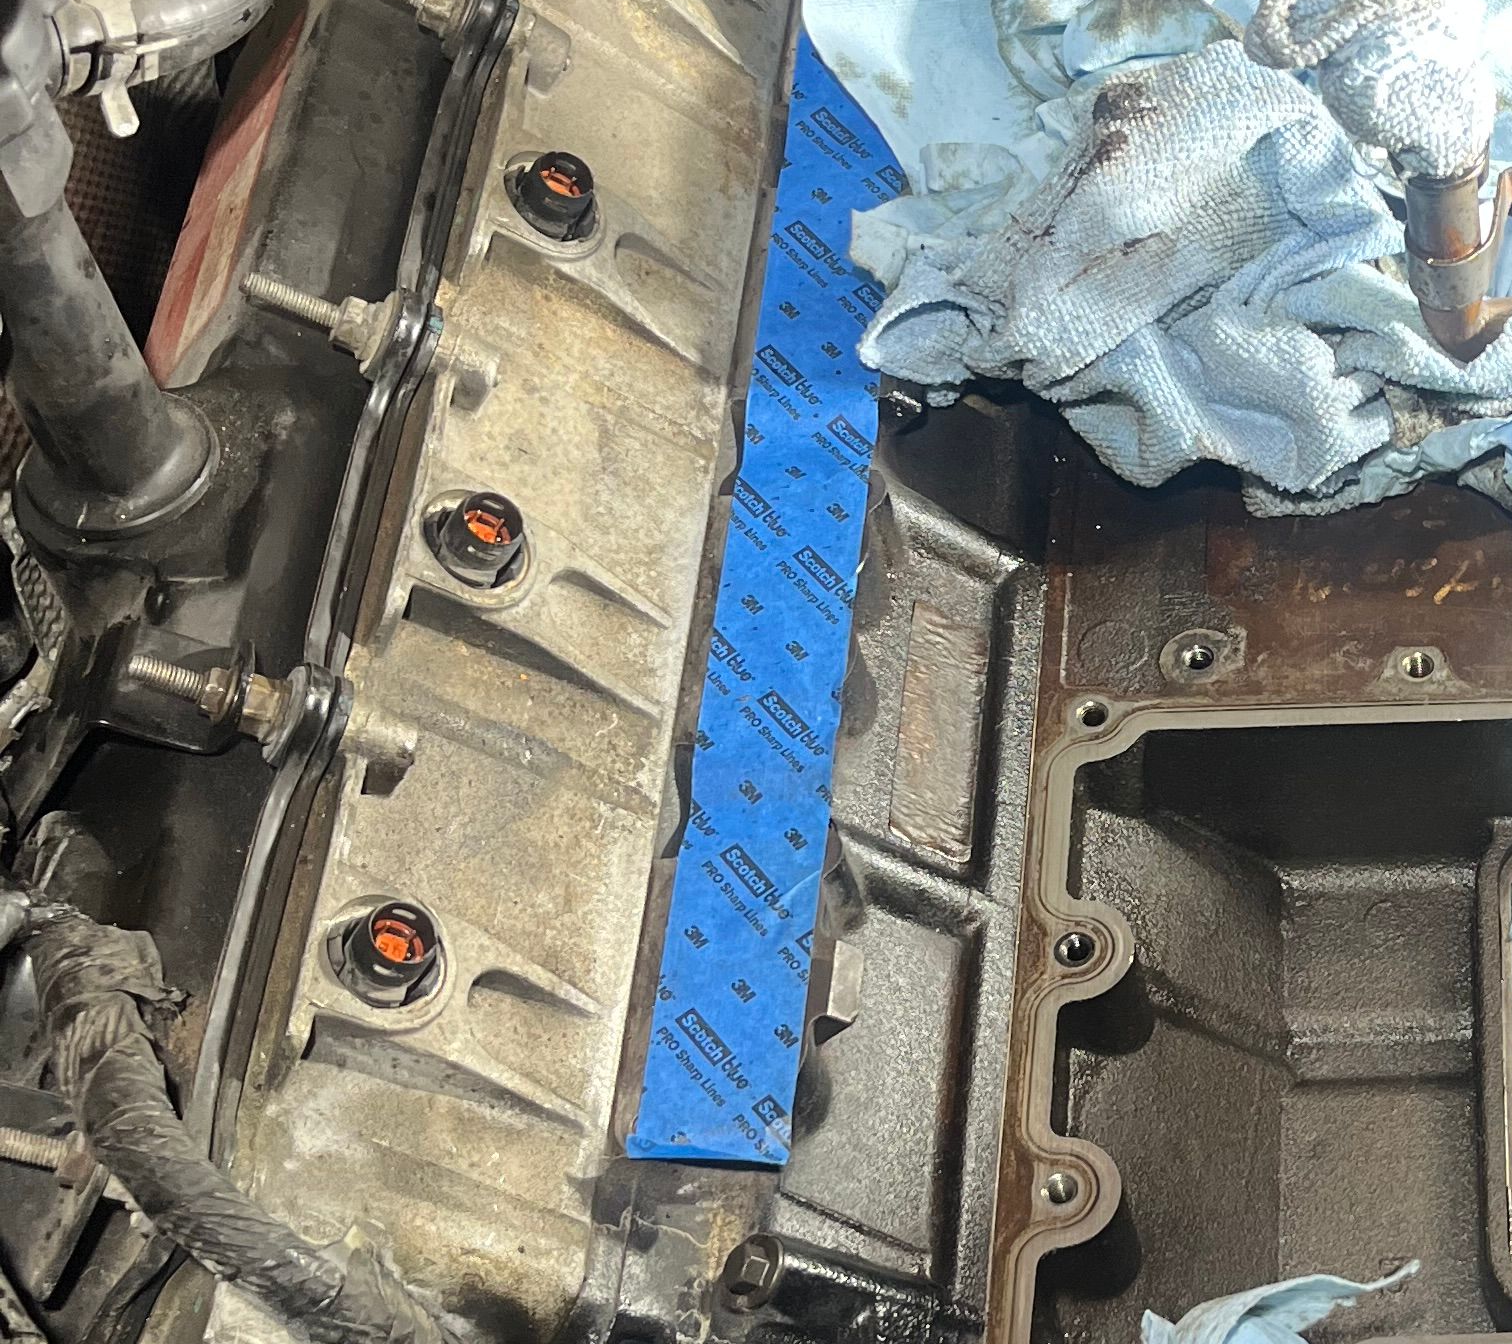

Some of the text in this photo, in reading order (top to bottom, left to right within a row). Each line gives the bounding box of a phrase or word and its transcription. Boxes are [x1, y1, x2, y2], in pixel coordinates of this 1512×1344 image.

[796, 120, 852, 170] PRO Sharp Lines
[814, 110, 870, 159] Scotch blue
[811, 186, 831, 204] 3M
[860, 176, 879, 194] PRO
[770, 232, 830, 288] PRO Sharp Lines
[787, 222, 848, 276] Scotch blue
[779, 299, 799, 320] 3M
[837, 295, 856, 314] PRO
[820, 340, 841, 360] 3M
[758, 347, 822, 405] Scotch blue
[755, 375, 801, 419] Sharp Lines
[742, 423, 764, 445] 3M
[831, 420, 869, 456] Scotch
[811, 431, 831, 449] PRO
[827, 445, 851, 467] Sharp
[785, 463, 806, 482] 3M
[762, 510, 790, 539] blue
[826, 501, 848, 523] 3M
[744, 527, 768, 551] Lines
[797, 547, 838, 589] Scotch
[741, 593, 763, 615] 3M
[776, 559, 840, 626] PRO Sharp Lines
[785, 639, 808, 662] 3M
[726, 653, 755, 683] blue
[707, 671, 731, 696] Lines
[762, 692, 829, 758] Scotch blue
[691, 729, 713, 751] 3M
[739, 705, 805, 773] PRO Sharp Lines
[737, 779, 762, 804] 3M
[691, 810, 719, 839] blue
[783, 826, 808, 850] 3M
[724, 846, 795, 920] Scotch blue
[701, 860, 770, 936] PRO Sharp Lines
[683, 923, 708, 950] 3M
[777, 946, 800, 970] PRO
[730, 977, 755, 1004] 3M
[772, 1022, 798, 1049] 3M
[679, 1011, 753, 1091] Scotch blue
[656, 1026, 727, 1107] PRO Sharp Lines
[733, 1114, 758, 1140] PRO
